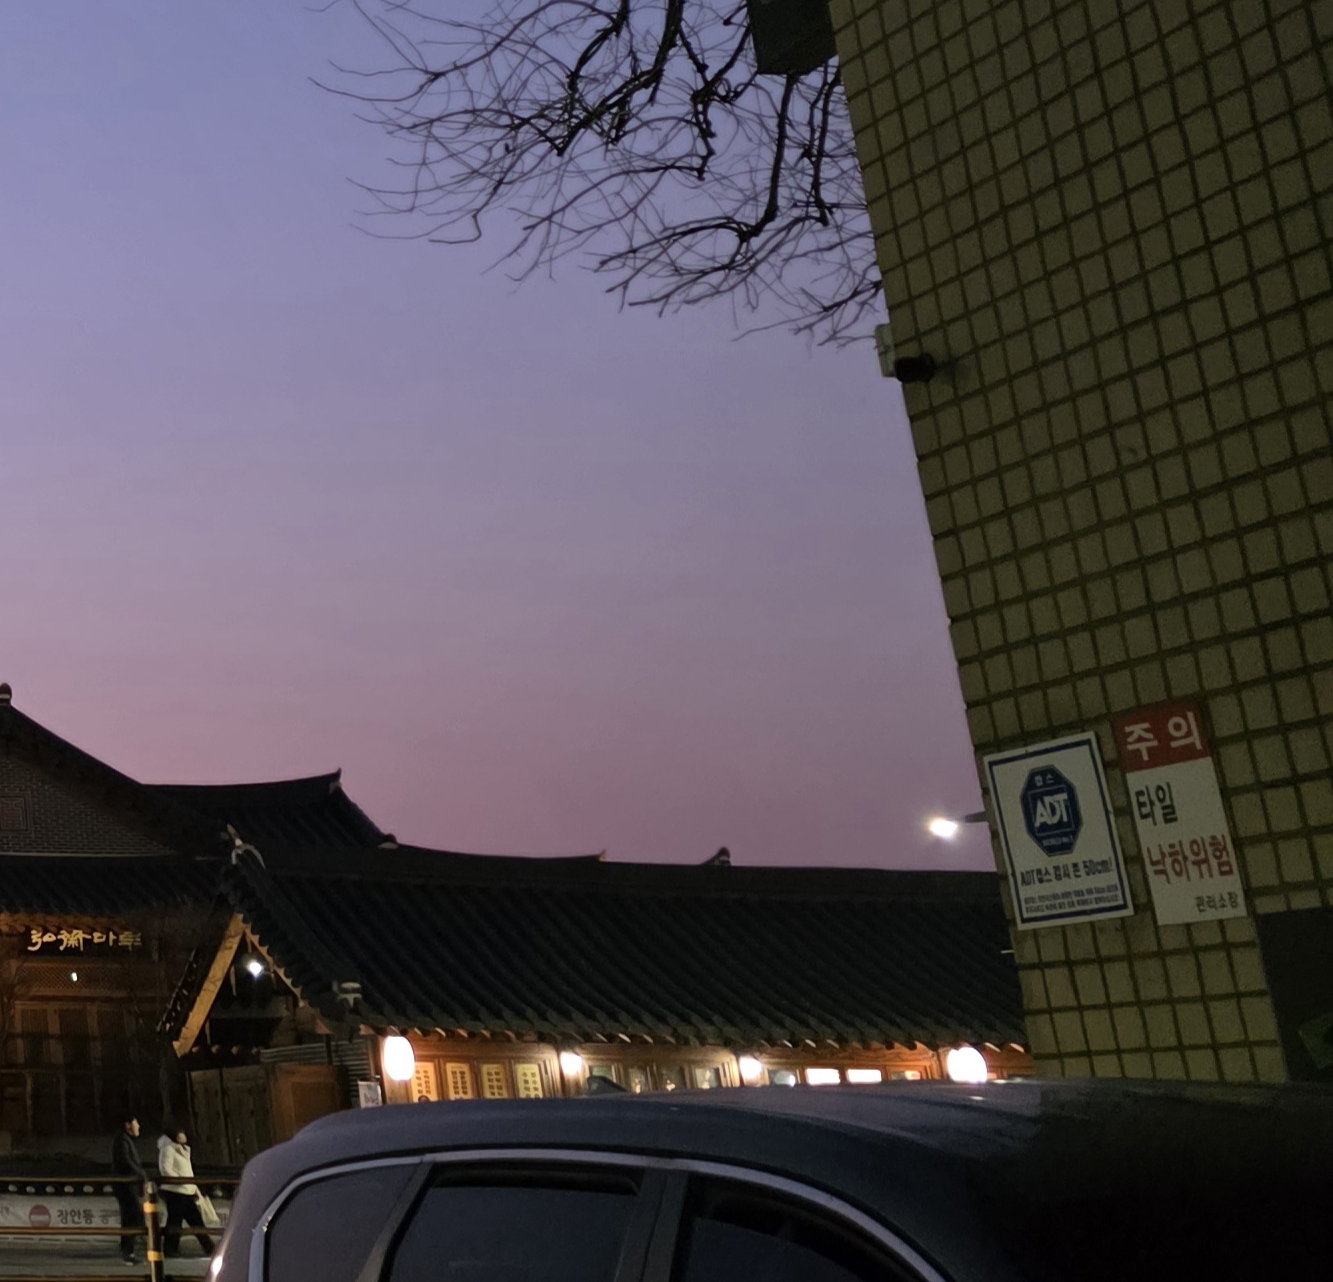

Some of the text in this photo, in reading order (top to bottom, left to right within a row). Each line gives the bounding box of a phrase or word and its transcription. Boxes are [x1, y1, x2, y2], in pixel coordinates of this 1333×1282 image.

[1124, 711, 1203, 761] 주의
[1035, 793, 1068, 828] ADT
[1135, 781, 1178, 826] 타일
[1146, 834, 1235, 884] 낙하위험
[1195, 892, 1239, 913] 관리소장
